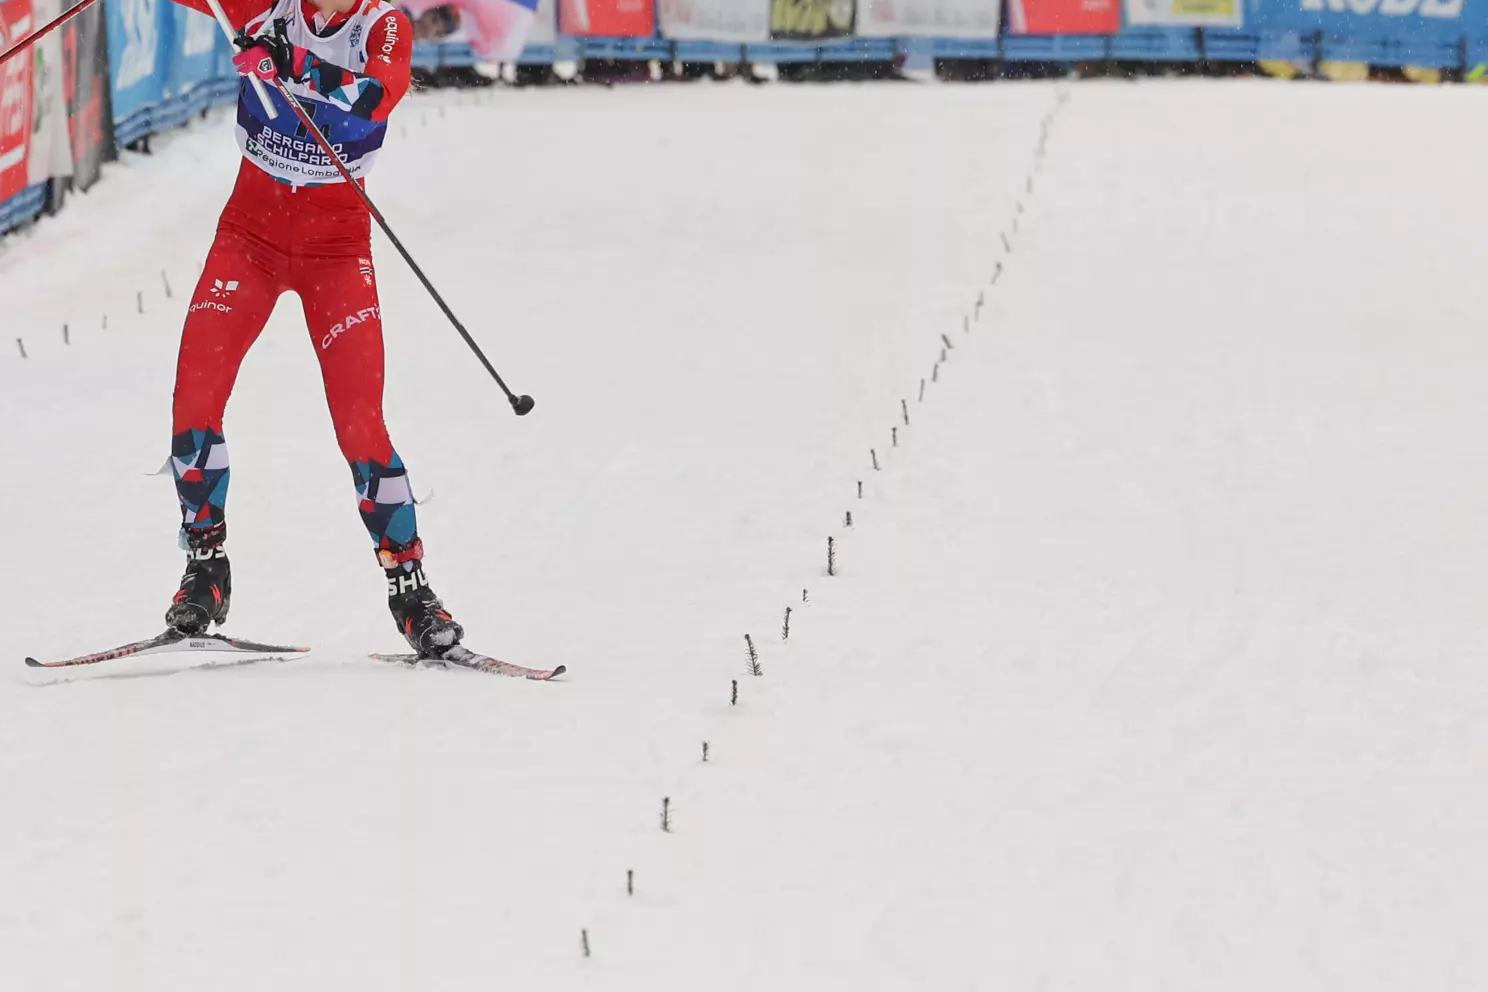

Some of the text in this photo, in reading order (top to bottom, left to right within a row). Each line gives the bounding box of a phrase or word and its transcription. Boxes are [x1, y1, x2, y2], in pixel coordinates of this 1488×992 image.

[382, 16, 399, 55] equinor
[257, 133, 348, 165] SCHILPARO
[301, 165, 361, 177] Lombaia
[322, 307, 377, 349] CRAFT
